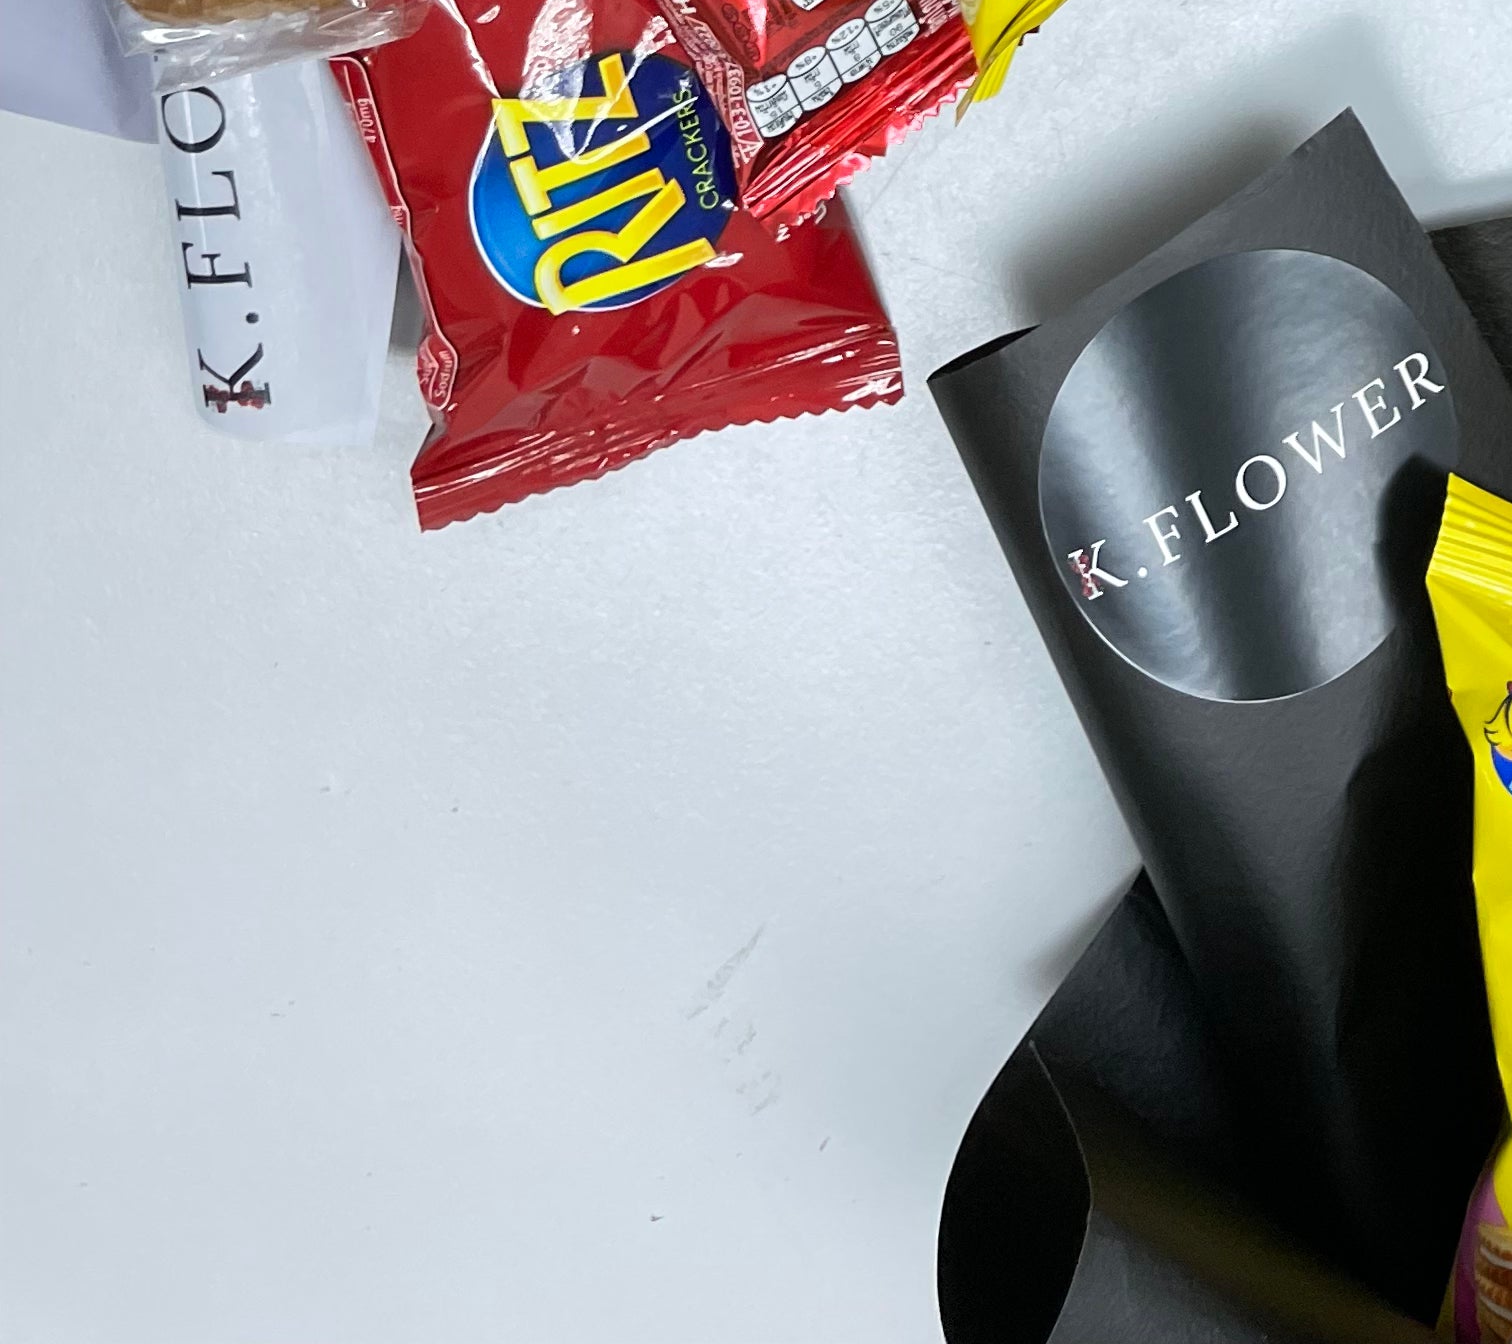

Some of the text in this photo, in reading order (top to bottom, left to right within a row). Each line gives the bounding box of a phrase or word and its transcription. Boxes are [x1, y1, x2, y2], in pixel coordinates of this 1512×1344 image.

[161, 85, 272, 411] K.FLO
[492, 53, 718, 314] RITZ
[674, 78, 719, 211] CRACKERS
[422, 348, 461, 398] Sodium
[1068, 352, 1445, 600] K.FLOWER
